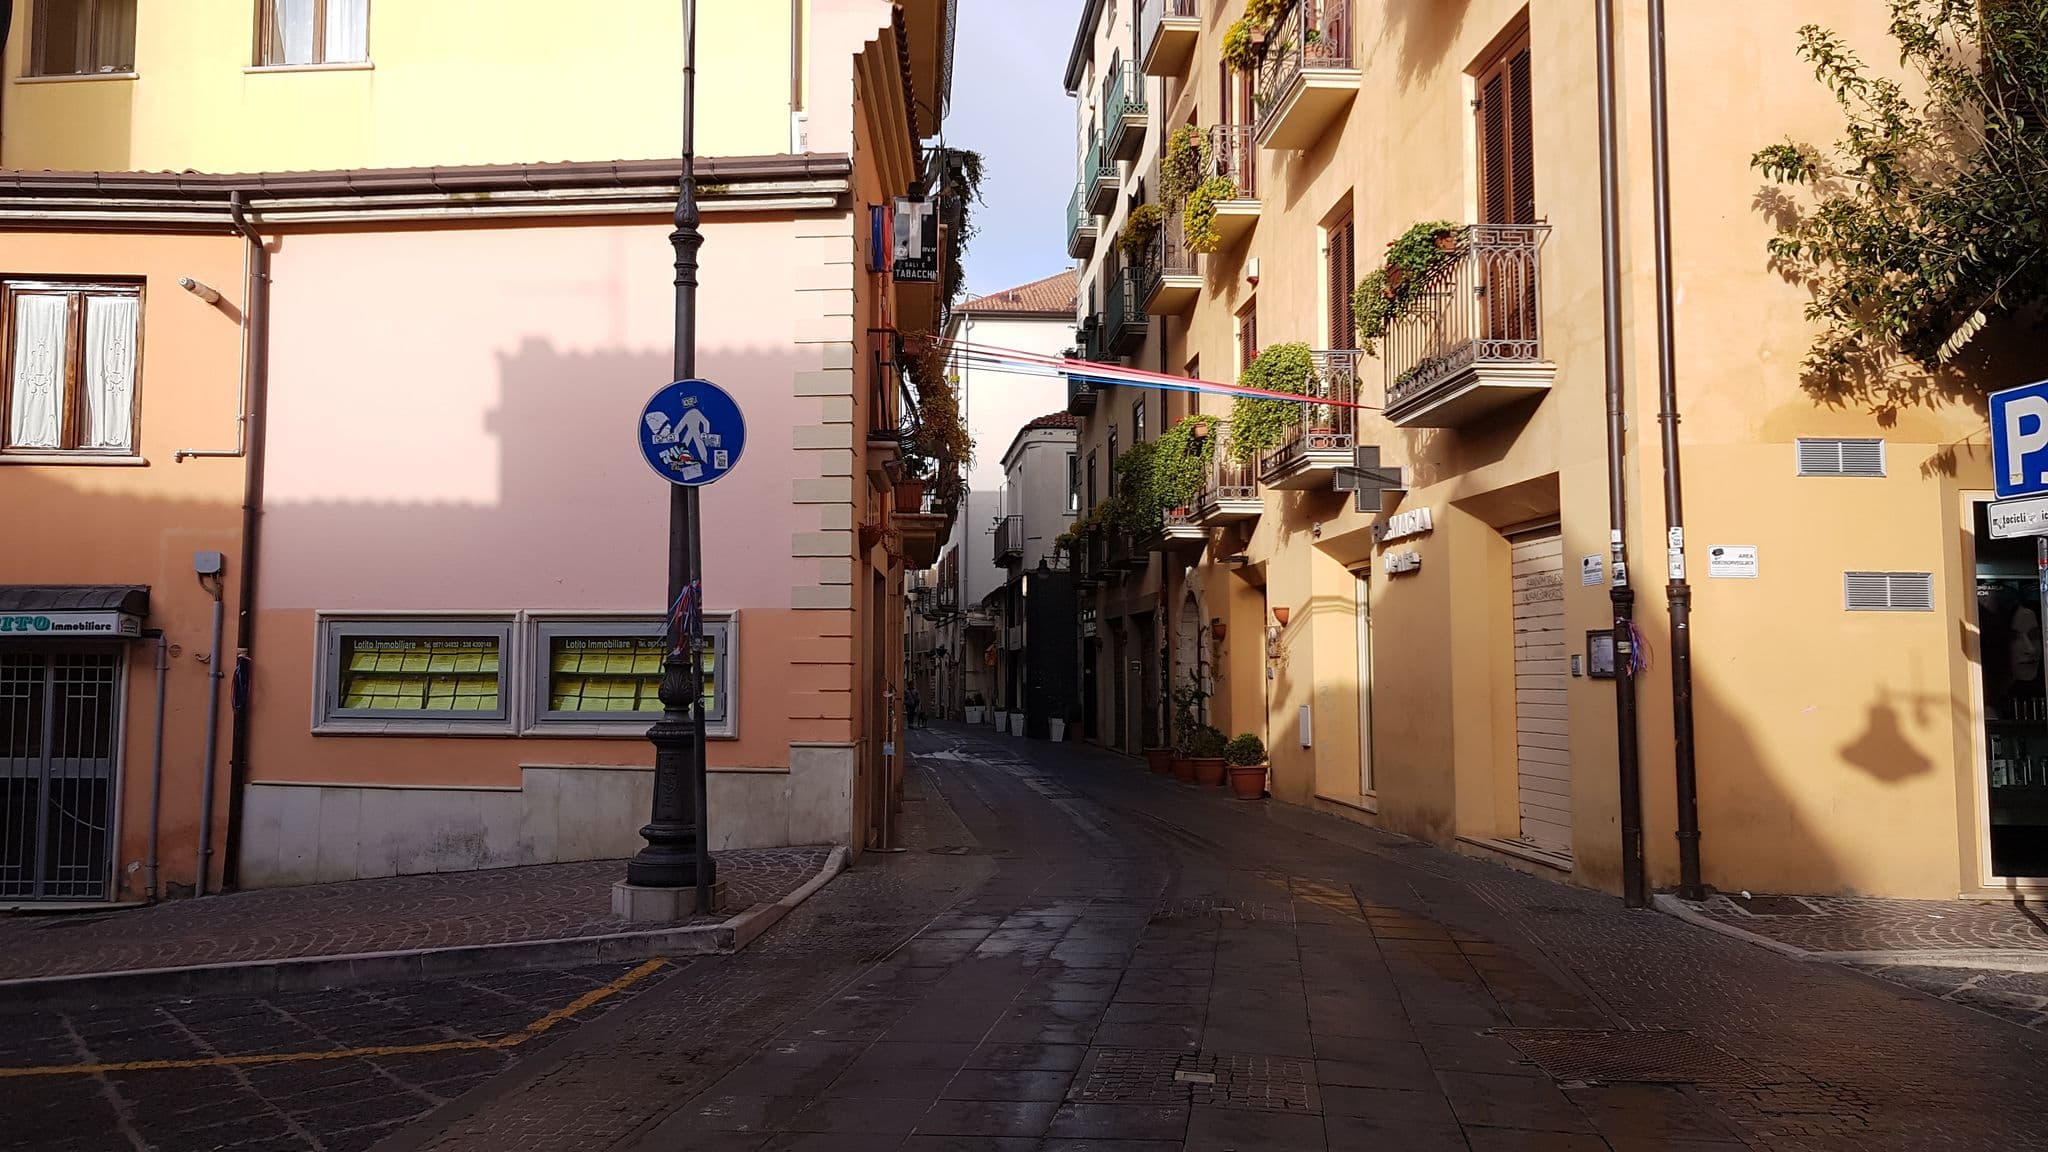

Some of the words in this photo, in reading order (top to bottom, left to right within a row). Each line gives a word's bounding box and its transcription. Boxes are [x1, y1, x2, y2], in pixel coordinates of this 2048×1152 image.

[898, 202, 933, 258] T
[895, 269, 936, 280] TABACCHI
[2004, 395, 2048, 486] P
[0, 616, 50, 631] ITO
[51, 621, 112, 631] Immobiliare
[353, 640, 375, 649] Lotito
[375, 640, 417, 649] Immobiliare
[566, 640, 586, 649] Lotito
[587, 639, 631, 649] Immobiliare
